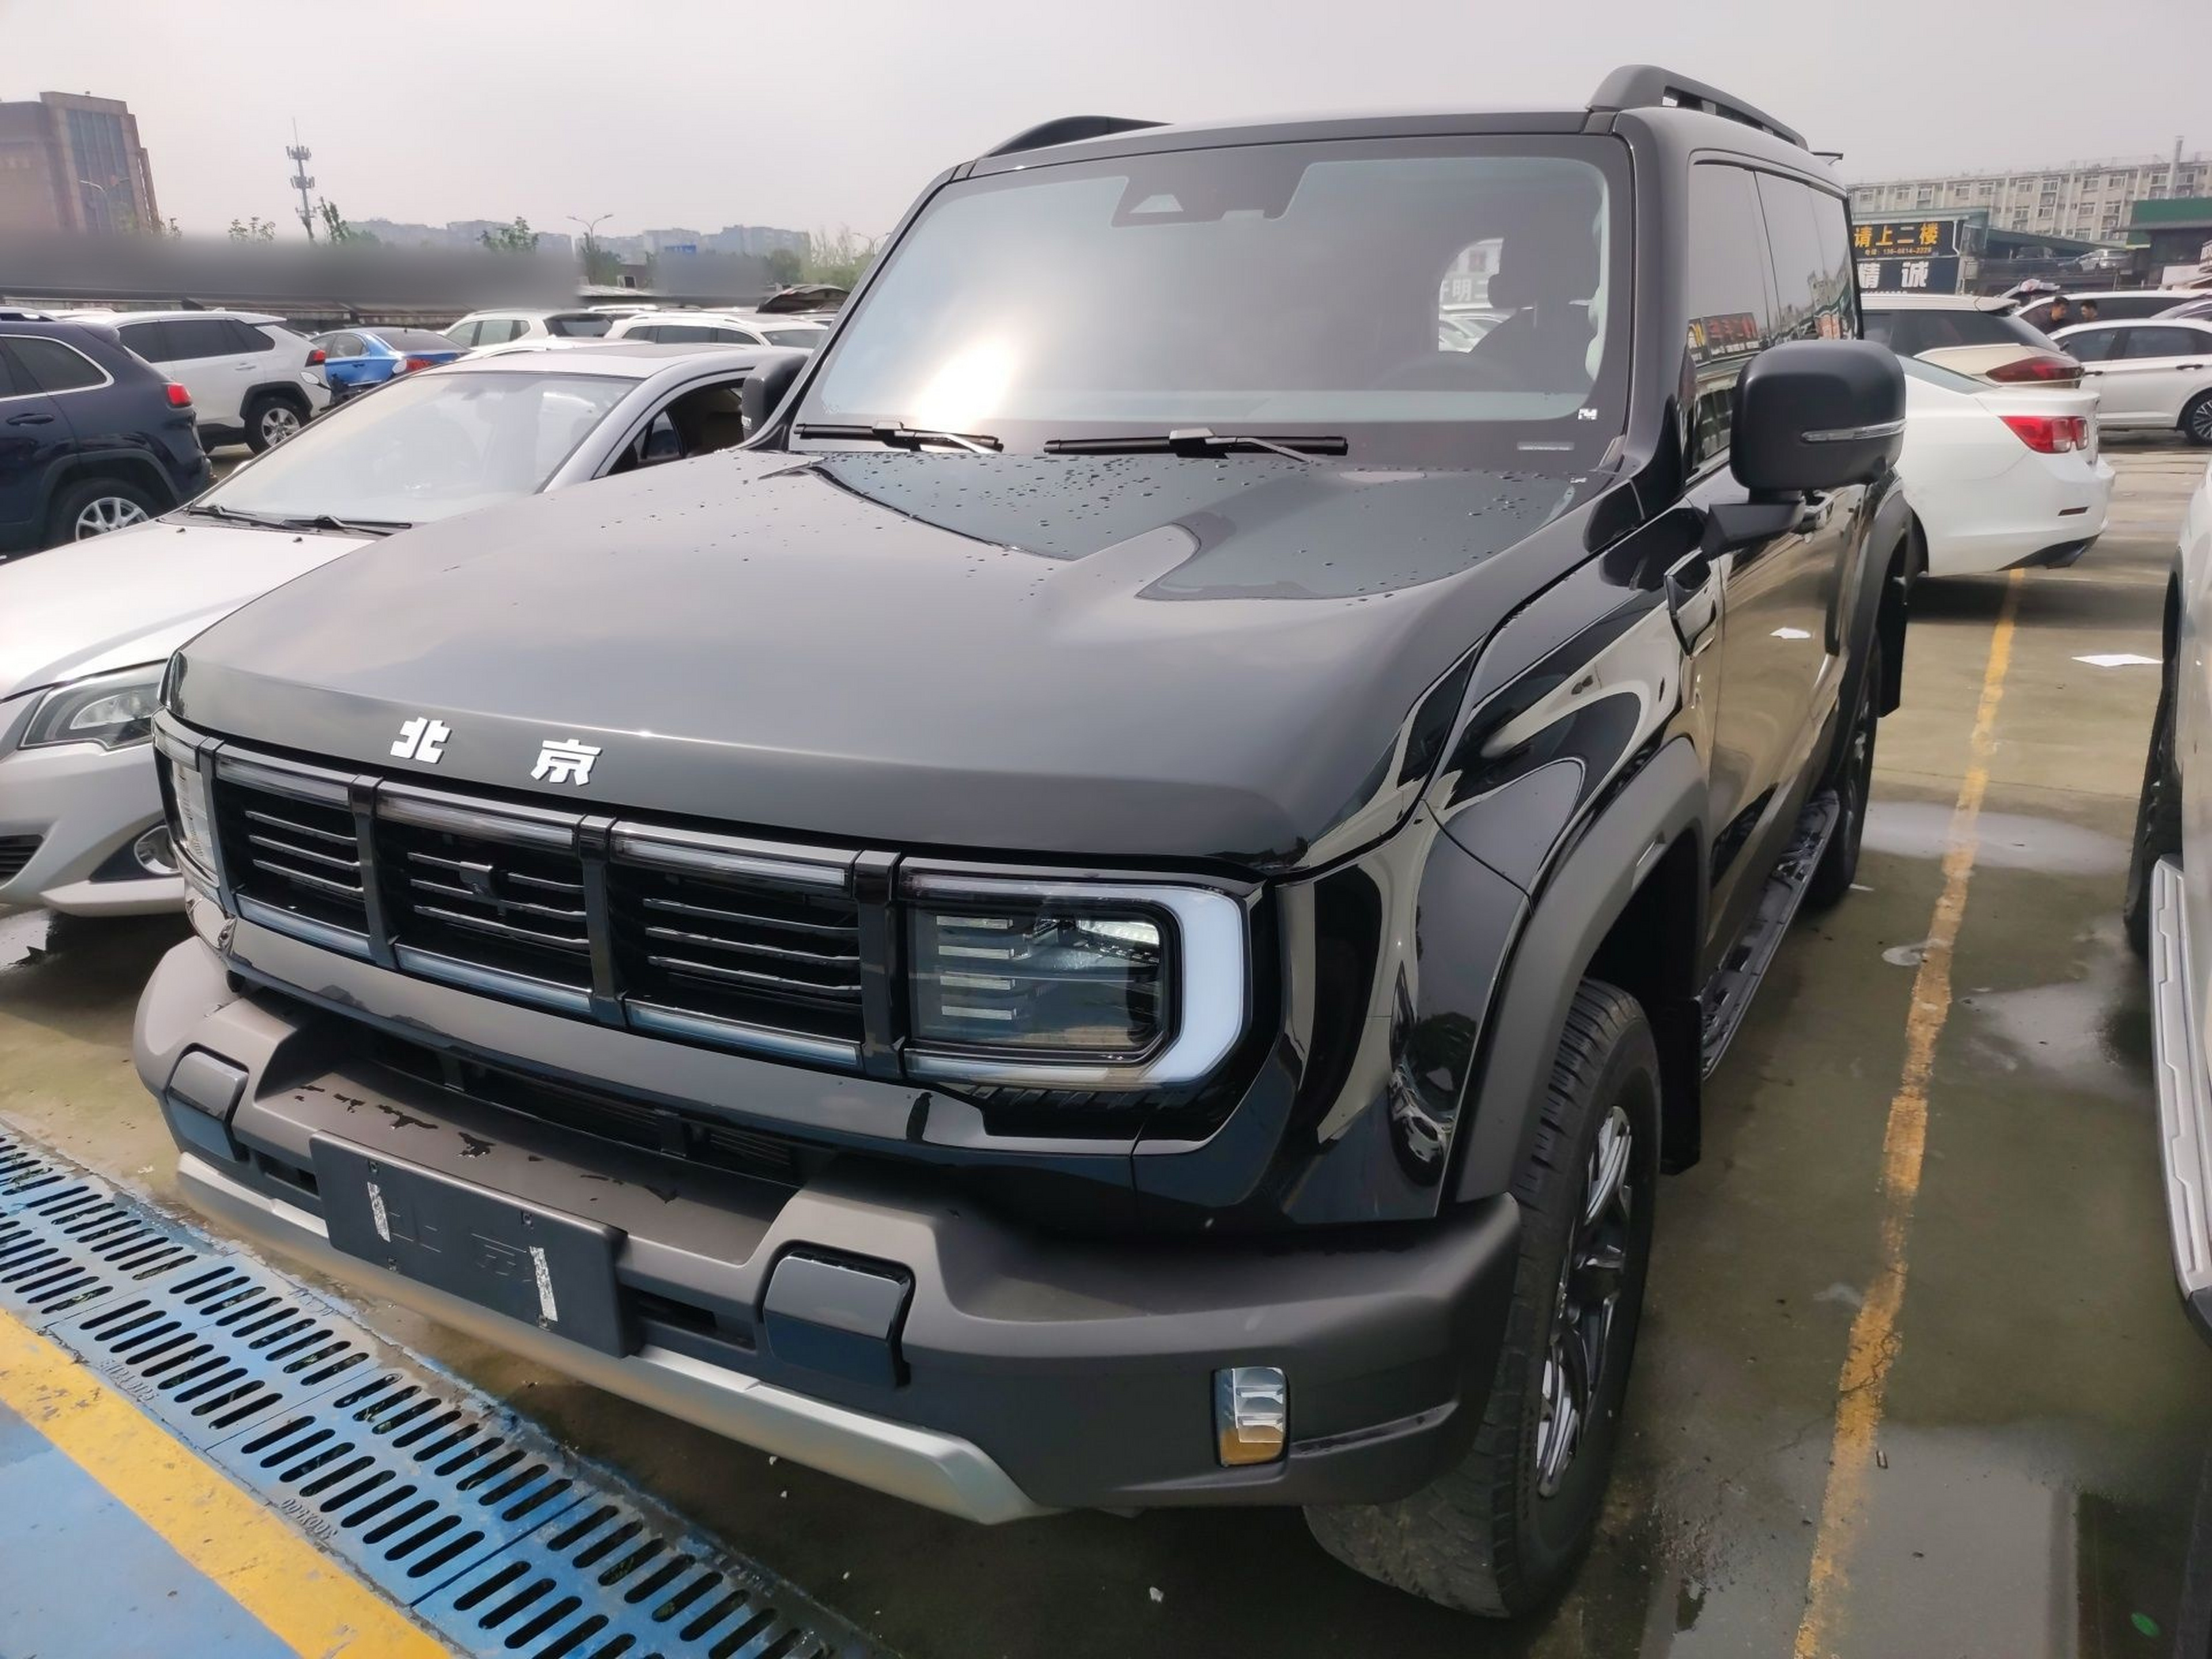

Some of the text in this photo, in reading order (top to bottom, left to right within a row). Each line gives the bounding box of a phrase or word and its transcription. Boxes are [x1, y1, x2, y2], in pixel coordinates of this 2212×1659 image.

[1854, 223, 1938, 247] 请上二楼
[390, 716, 603, 787] 北京
